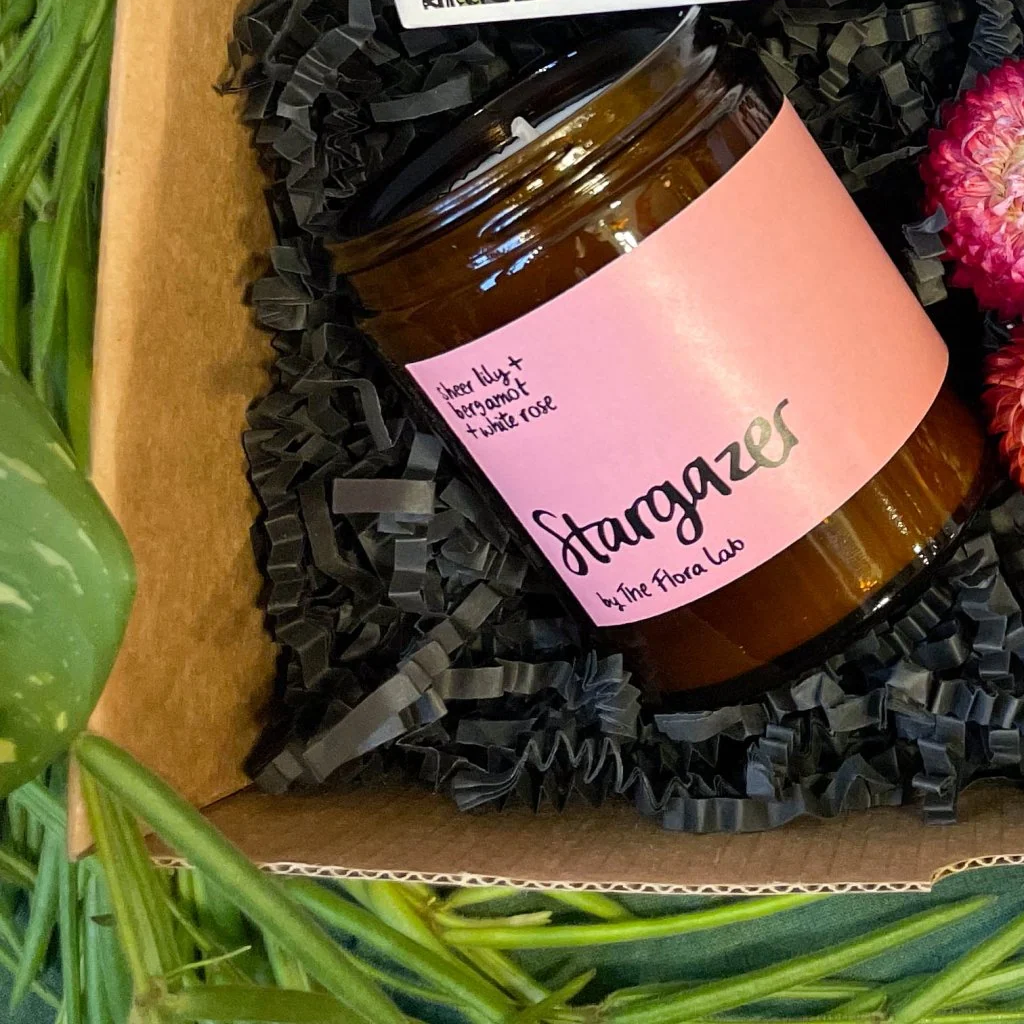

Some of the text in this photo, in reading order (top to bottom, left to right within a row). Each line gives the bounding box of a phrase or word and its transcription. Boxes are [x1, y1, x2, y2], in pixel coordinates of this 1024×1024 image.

[436, 381, 475, 401] sheer
[471, 364, 511, 387] lily
[447, 377, 530, 419] bergamot
[479, 411, 519, 437] white
[519, 395, 557, 422] rose
[532, 398, 799, 576] Stargazer
[596, 538, 745, 612] by The Flora Lab
